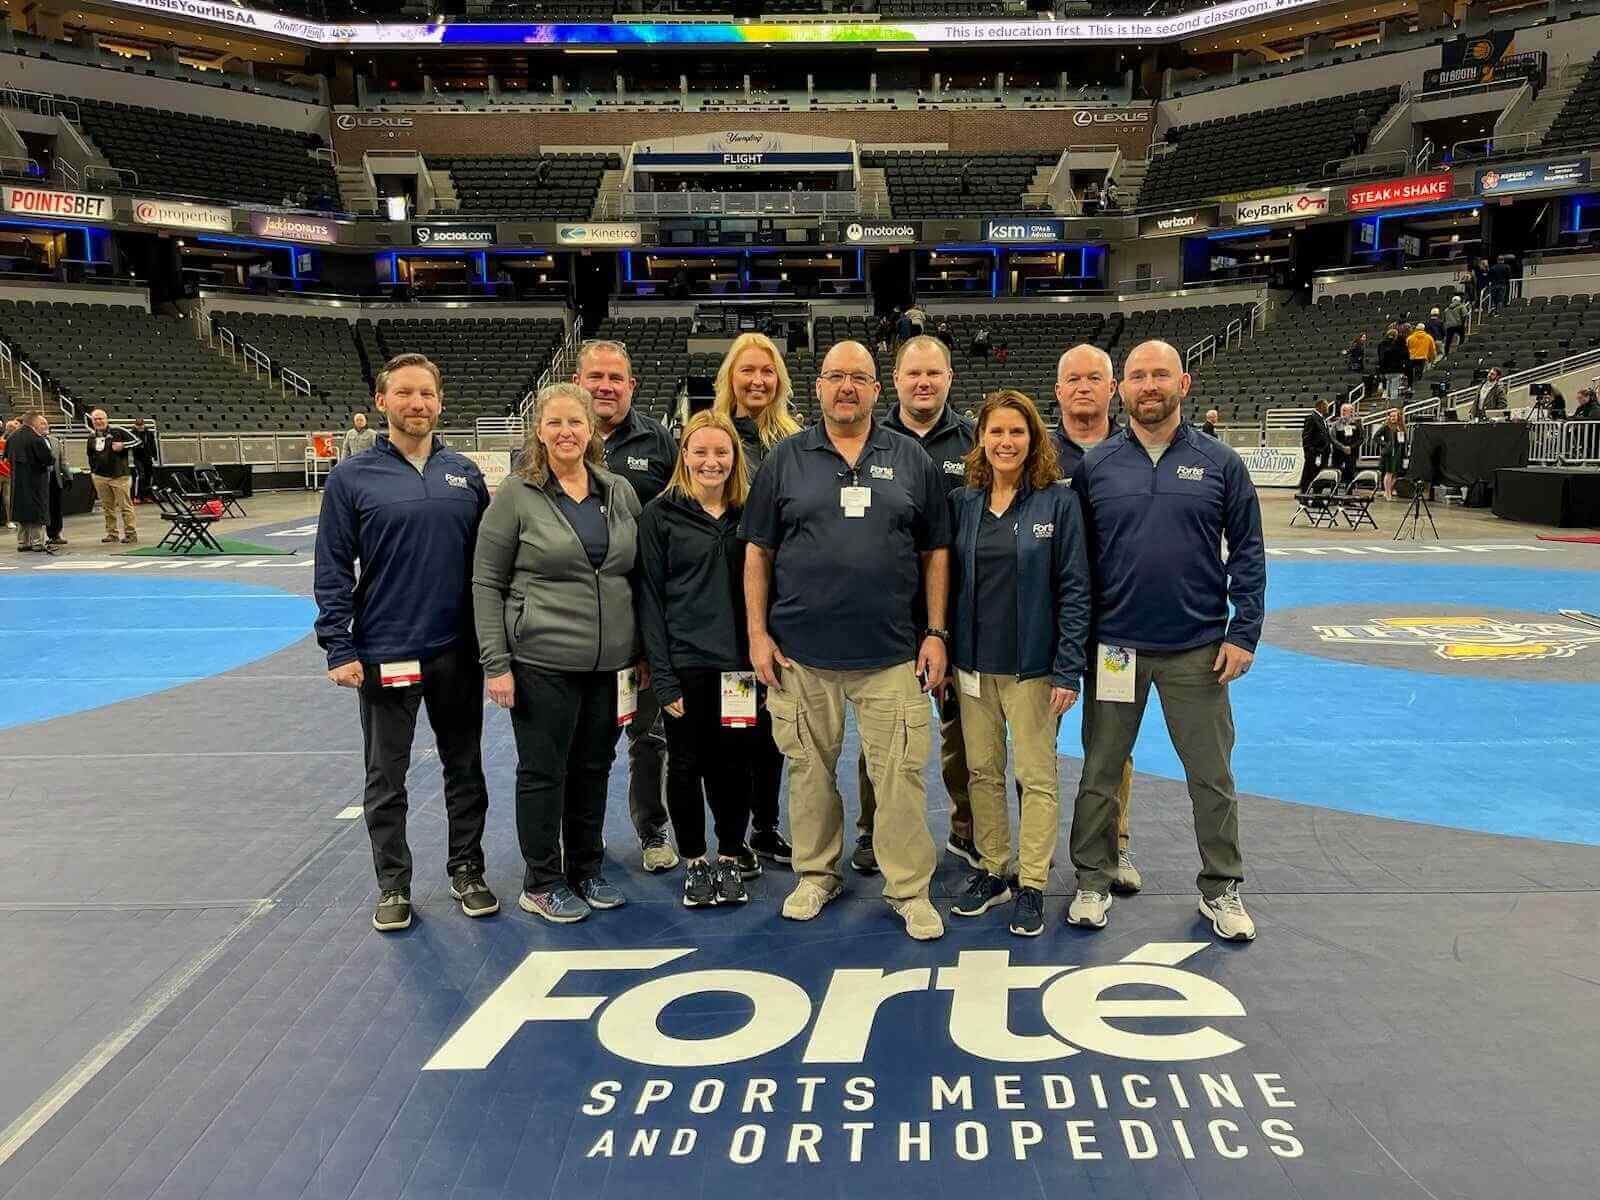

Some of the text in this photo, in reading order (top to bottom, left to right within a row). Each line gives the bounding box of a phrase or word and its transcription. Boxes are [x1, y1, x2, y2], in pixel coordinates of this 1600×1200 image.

[945, 26, 970, 38] This
[975, 26, 984, 38] is
[988, 25, 1052, 38] education
[1088, 24, 1113, 36] This
[1118, 24, 1128, 35] is
[1131, 24, 1152, 36] the
[1156, 16, 1200, 34] second
[357, 117, 414, 127] LEXUS
[1093, 112, 1149, 122] LEXUS
[723, 153, 763, 165] FLIGHT
[1351, 188, 1392, 205] STEAK
[1403, 181, 1449, 198] SHAKE
[11, 190, 105, 216] POINTSBET
[1238, 202, 1294, 221] KeyBank
[287, 222, 328, 235] DONUTS
[1157, 216, 1194, 229] verizon
[433, 232, 492, 241] socios.com
[591, 228, 638, 239] Kinetico
[864, 225, 914, 236] motorola
[989, 221, 1025, 239] ksm
[1240, 456, 1296, 470] UNDATION
[421, 942, 1248, 1070] Forté
[581, 1073, 1296, 1116] SPORTS MEDICINE
[586, 1119, 1305, 1164] AND ORTHOPEDICS
